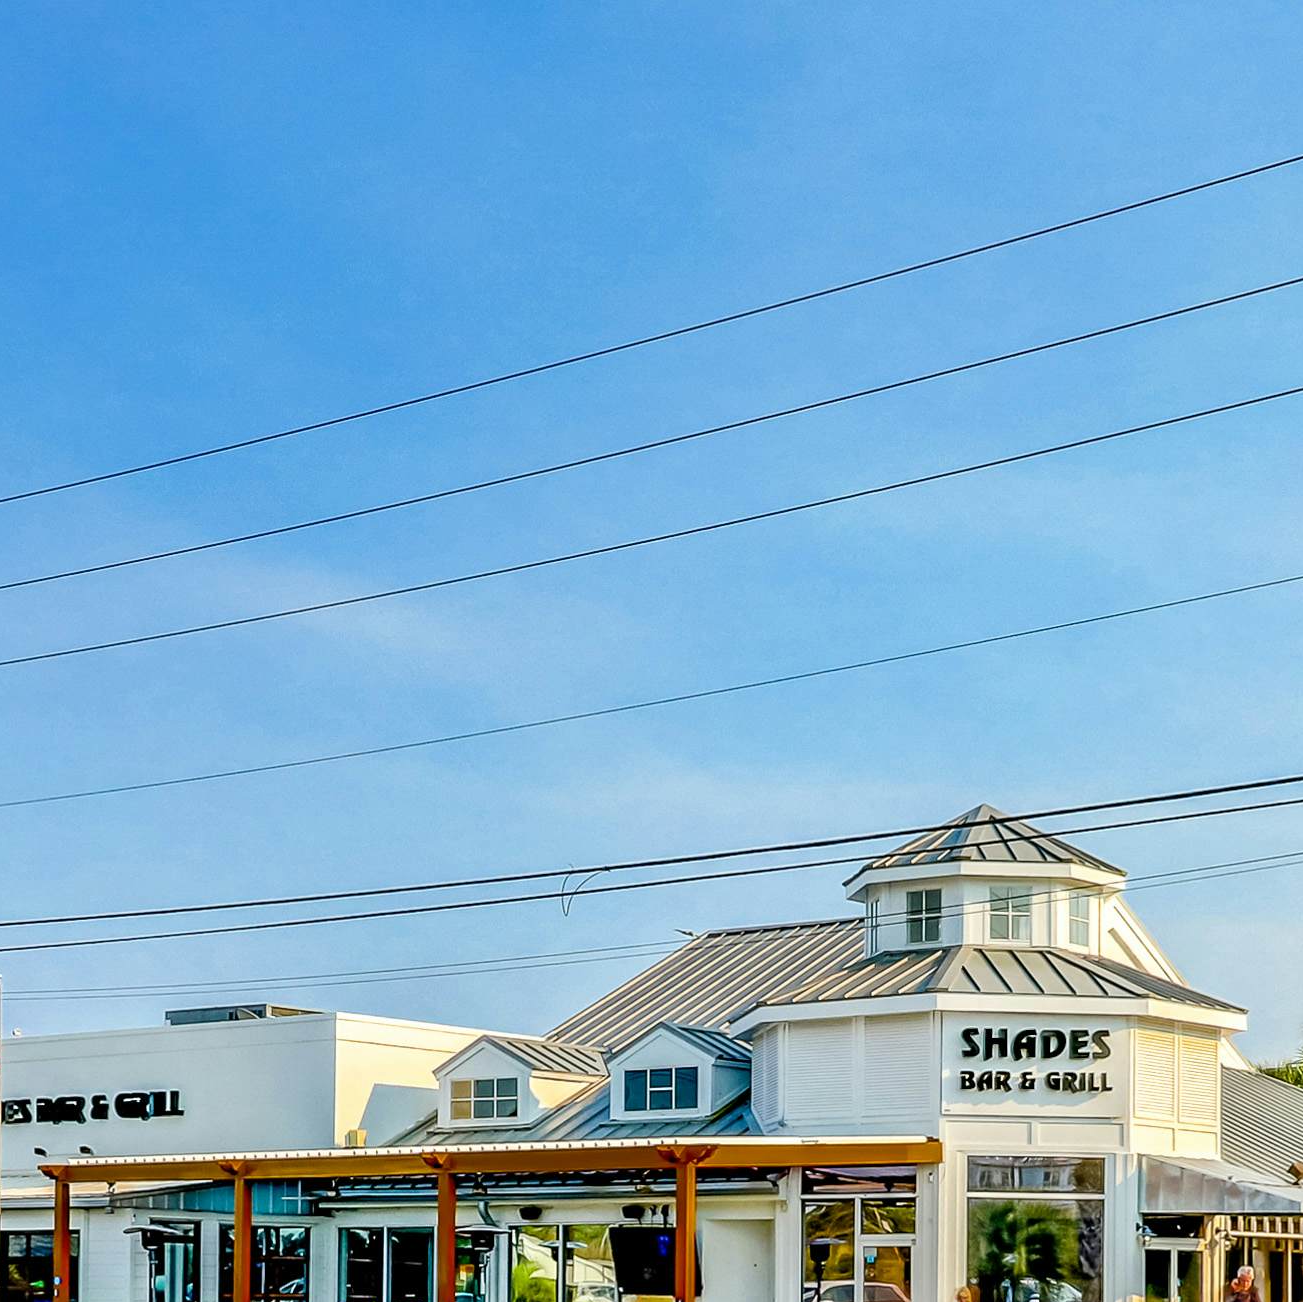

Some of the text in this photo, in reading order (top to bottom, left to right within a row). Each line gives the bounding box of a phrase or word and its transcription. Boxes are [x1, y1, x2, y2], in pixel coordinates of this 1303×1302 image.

[961, 1027, 1112, 1061] SHADES
[960, 1070, 1113, 1093] BAR & GRILL
